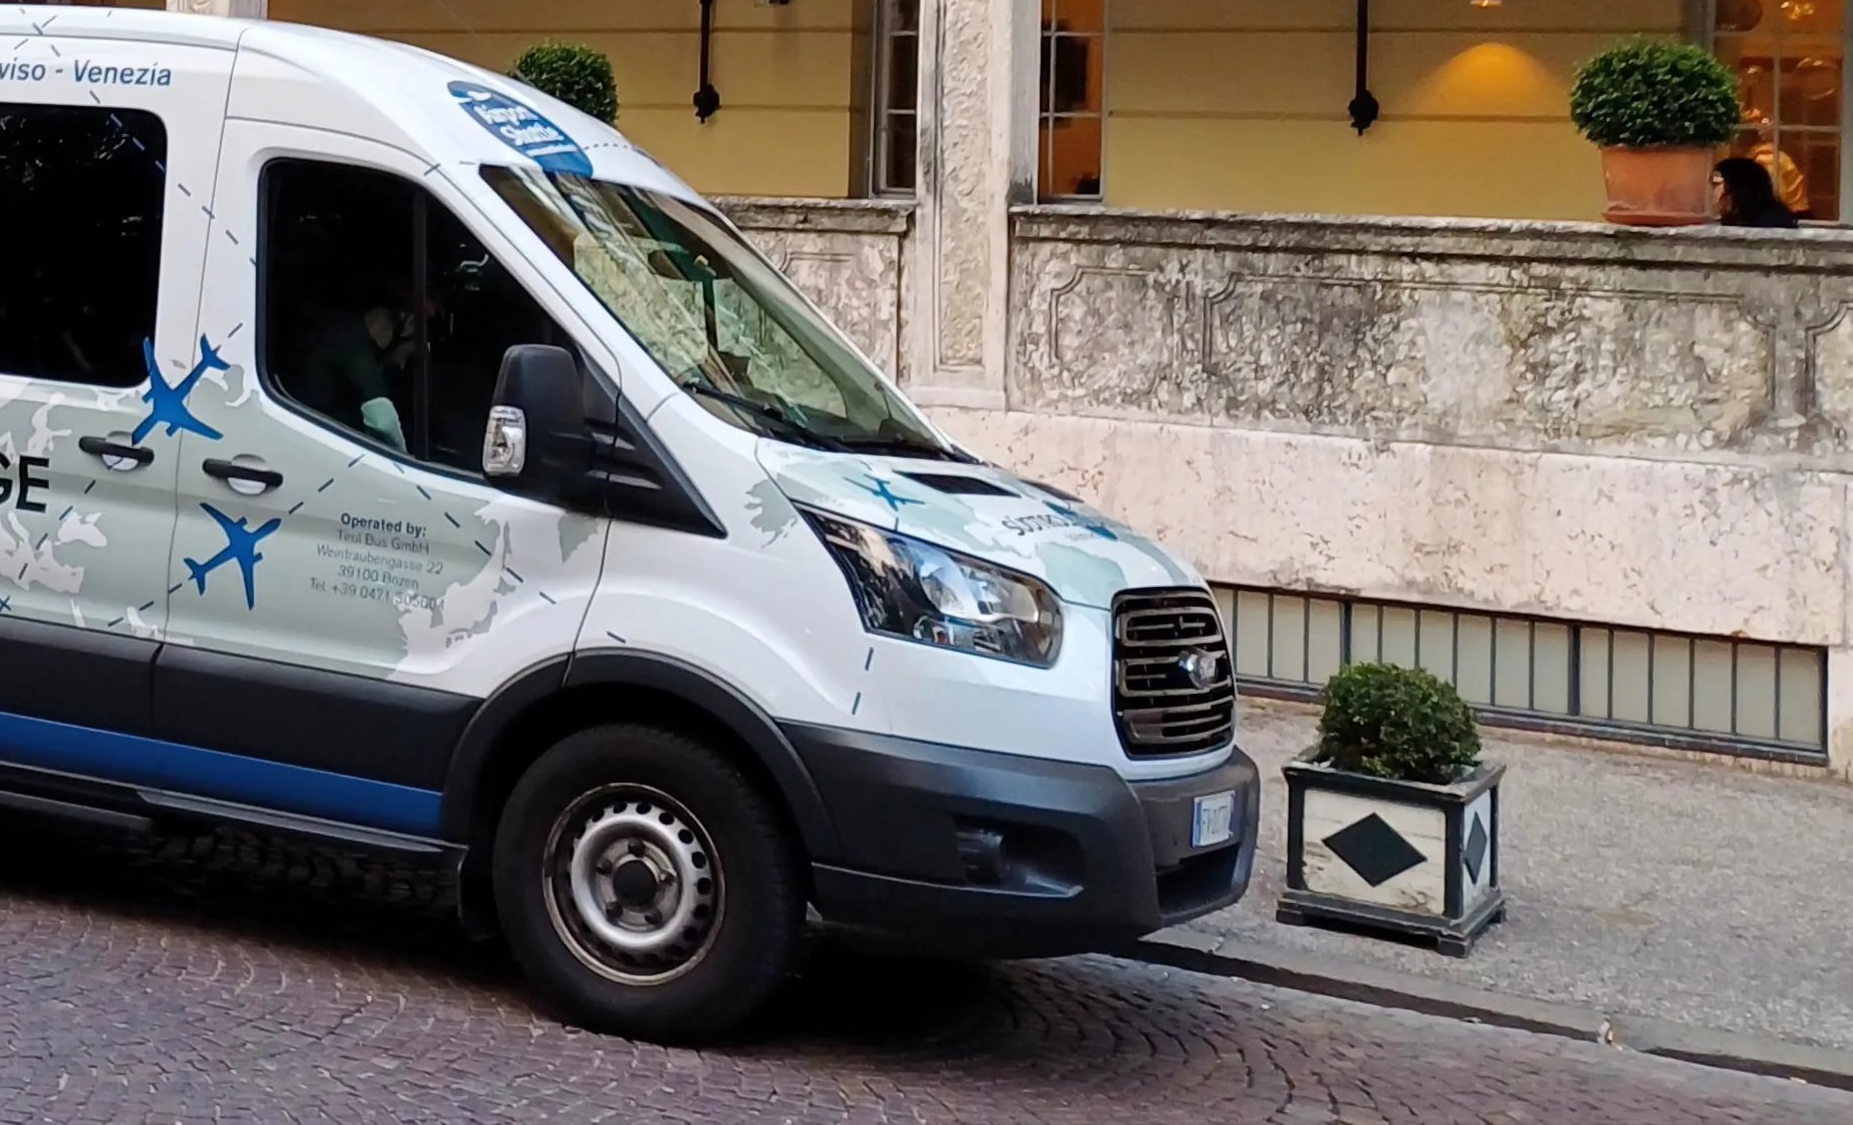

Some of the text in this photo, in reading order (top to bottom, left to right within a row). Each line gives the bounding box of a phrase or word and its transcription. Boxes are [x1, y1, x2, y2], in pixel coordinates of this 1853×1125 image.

[73, 59, 172, 86] Venezia
[340, 513, 427, 538] Operated by:
[365, 533, 388, 547] Bus
[391, 537, 429, 554] GmbH
[338, 565, 379, 582] 39100
[427, 562, 444, 574] 22
[359, 586, 390, 601] 0471
